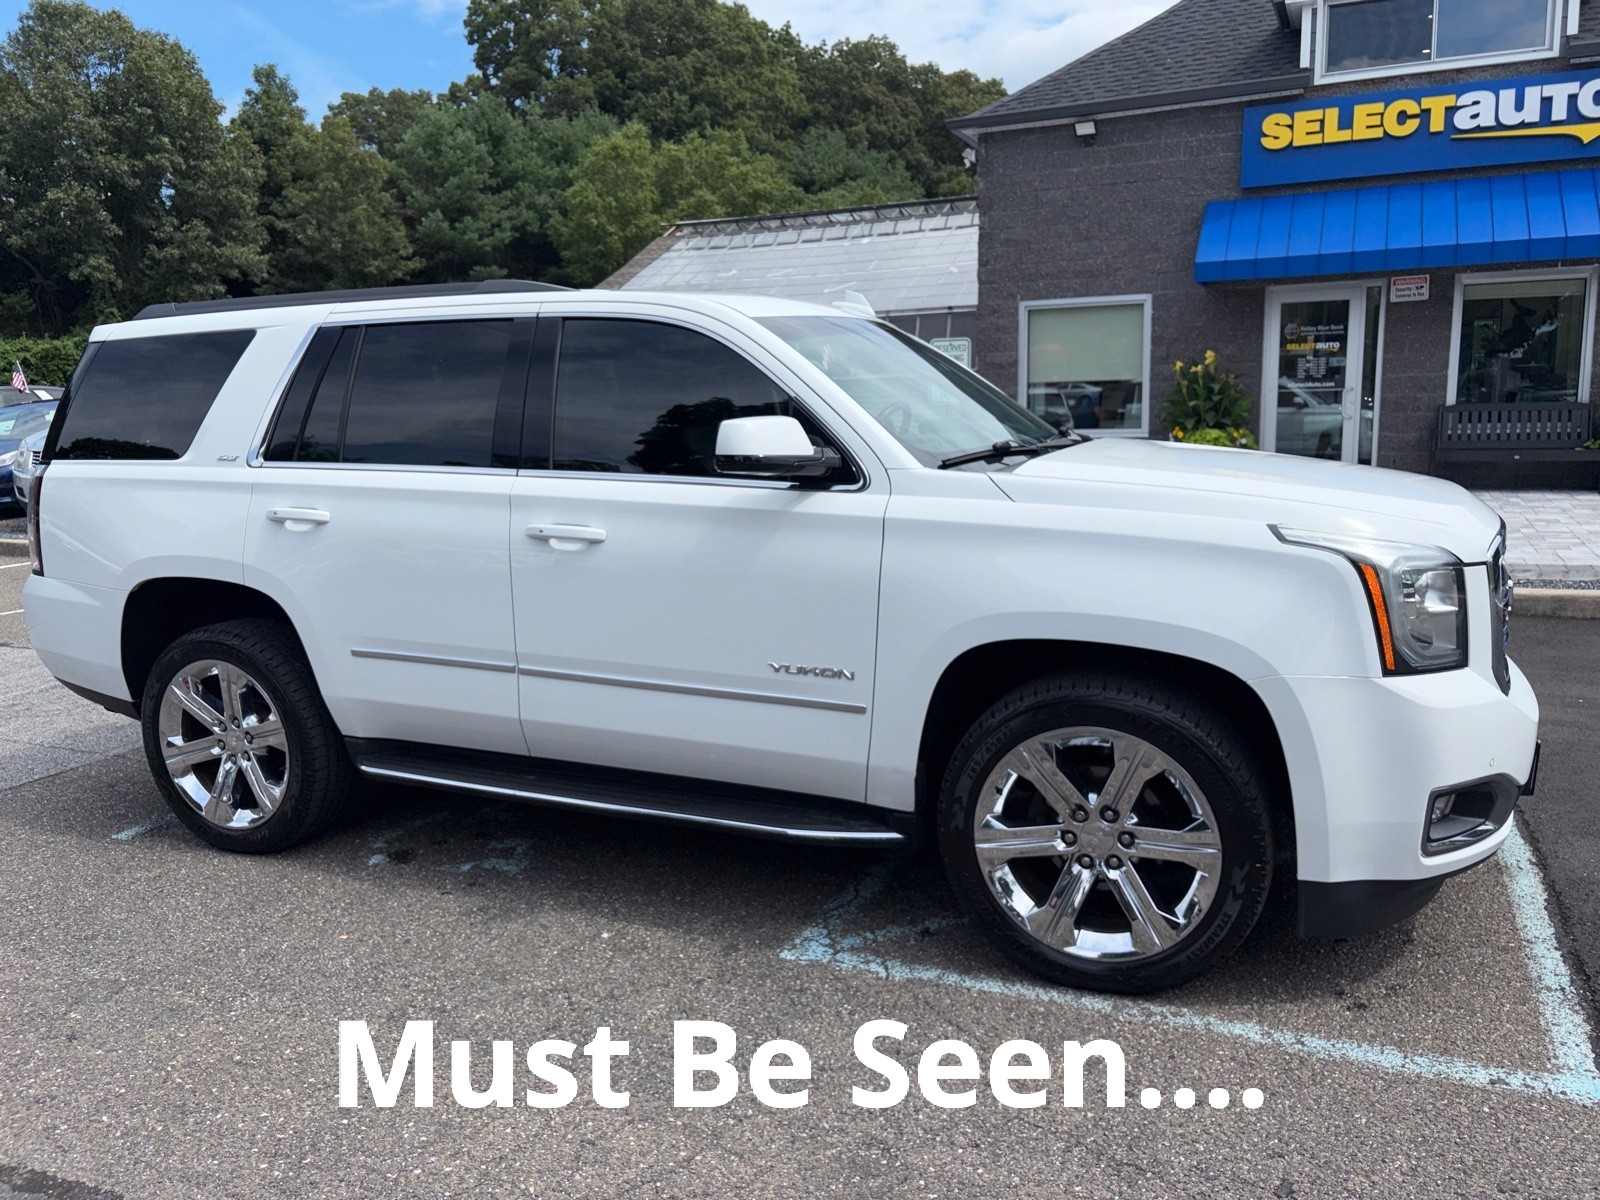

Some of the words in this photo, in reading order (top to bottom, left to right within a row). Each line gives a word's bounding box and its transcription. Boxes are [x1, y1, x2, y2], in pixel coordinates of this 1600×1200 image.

[1394, 278, 1426, 286] WARNING
[1300, 325, 1317, 333] Kelley
[1330, 323, 1345, 331] Book
[767, 661, 855, 680] YUKON
